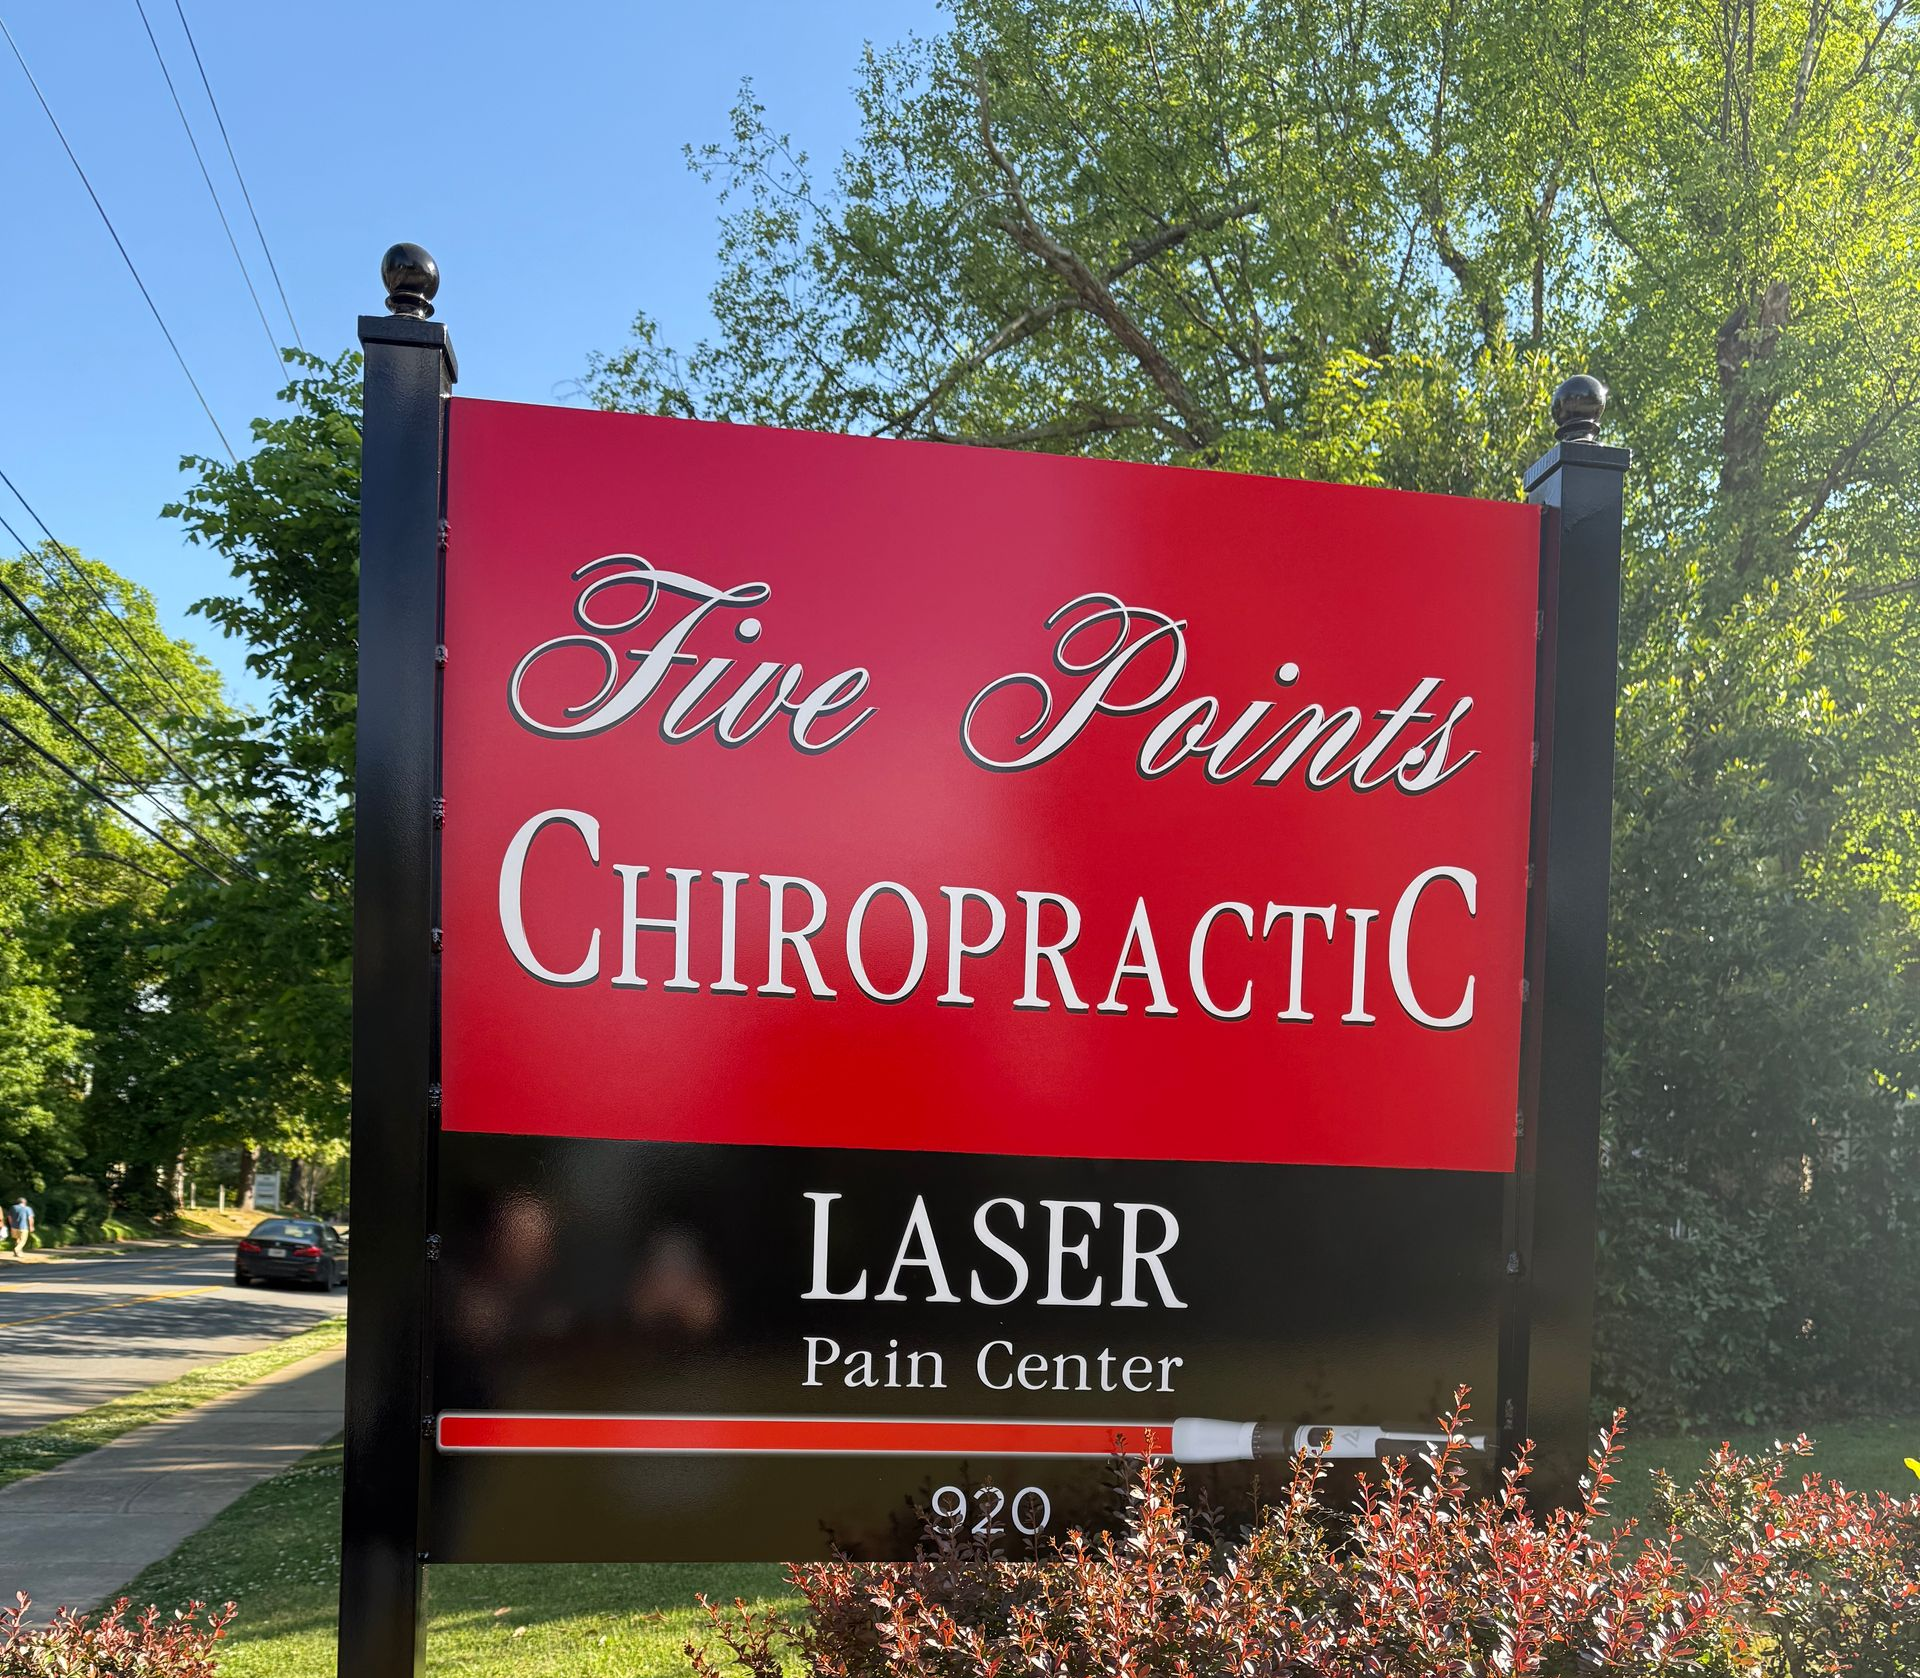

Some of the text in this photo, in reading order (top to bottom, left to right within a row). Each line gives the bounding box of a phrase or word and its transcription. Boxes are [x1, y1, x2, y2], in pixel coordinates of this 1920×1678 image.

[506, 552, 1482, 796] Five Points
[498, 808, 1479, 1030] CHIROPRACTIC
[800, 1191, 1189, 1309] LASER
[801, 1336, 1184, 1393] Pain Center
[931, 1485, 1052, 1536] 920
